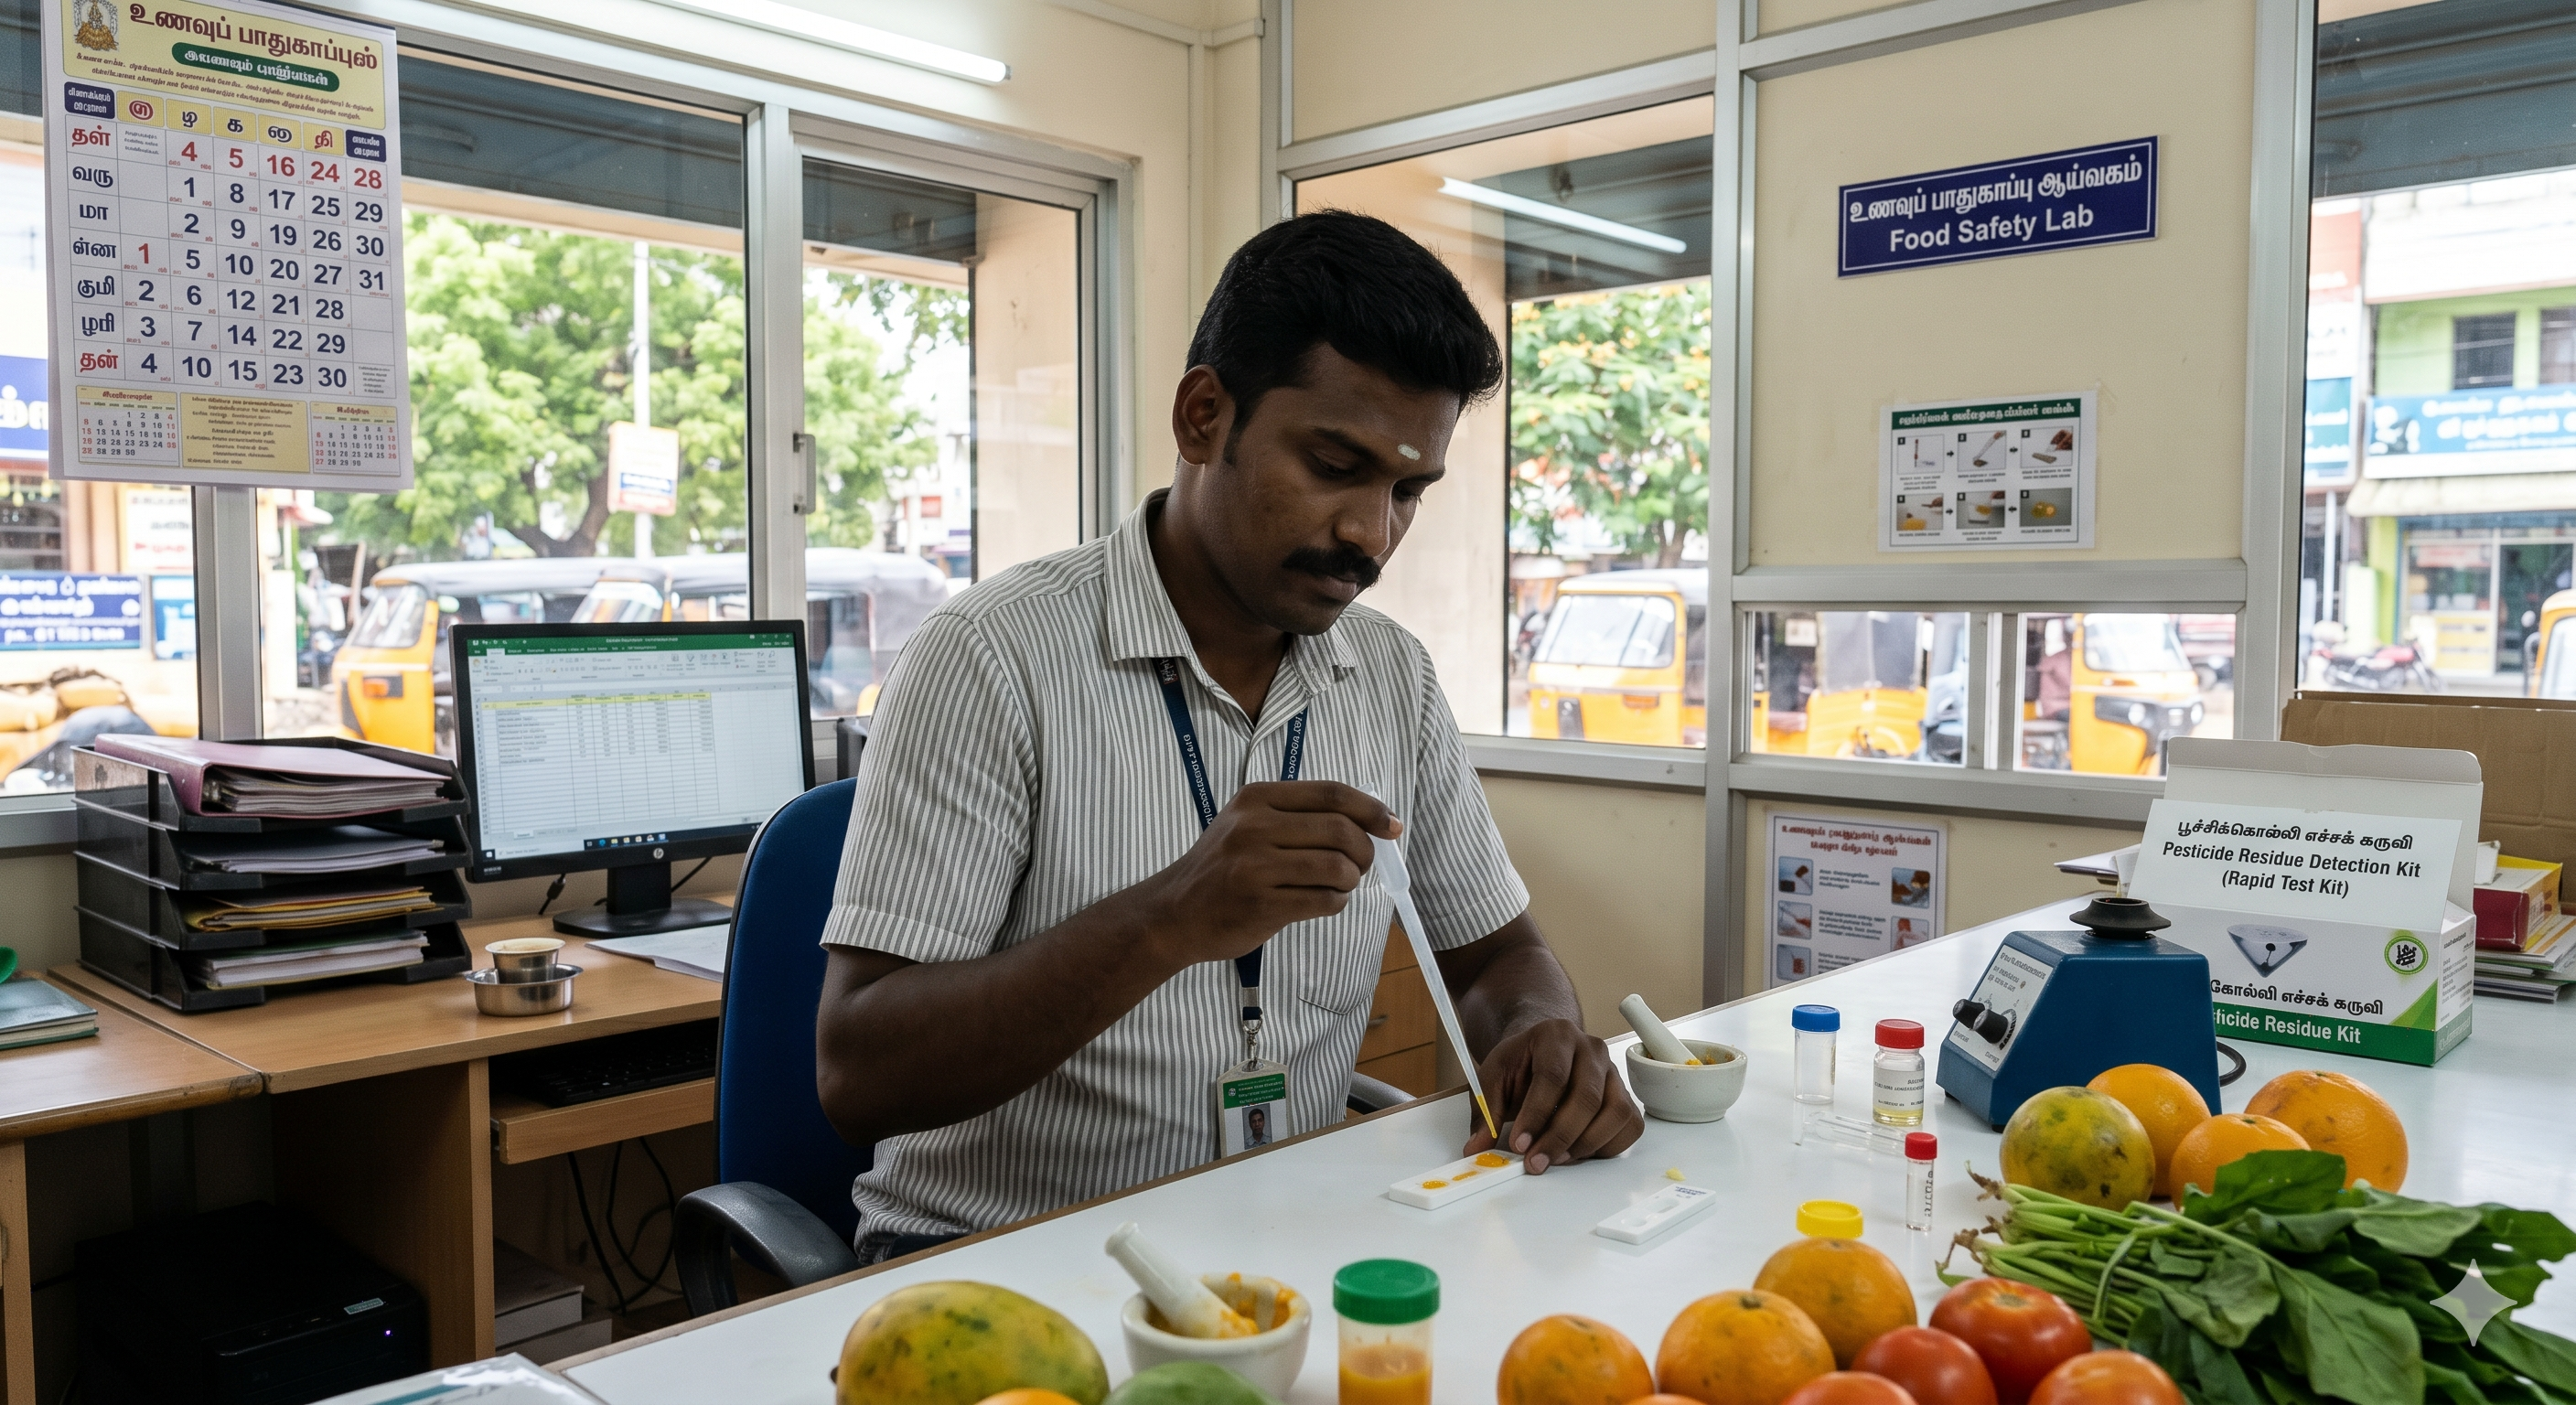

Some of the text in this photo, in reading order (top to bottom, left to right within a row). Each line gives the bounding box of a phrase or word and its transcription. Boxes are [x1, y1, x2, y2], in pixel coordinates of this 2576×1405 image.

[130, 3, 231, 42] உணவுப்
[227, 118, 243, 133] க
[182, 142, 198, 161] 4
[230, 148, 243, 168] 5
[267, 155, 295, 177] 16
[311, 161, 339, 182] 24
[354, 168, 381, 188] 28
[185, 177, 194, 197] 1
[231, 184, 243, 203] 8
[269, 189, 295, 209] 17
[312, 196, 339, 217] 25
[356, 202, 382, 222] 29
[1850, 154, 2142, 222] உணவுப் பாதுகாப்பு ஆய்வகம்
[80, 204, 383, 256] மா 2 9 19 26 30
[1890, 203, 2094, 252] Food Safety Lab
[139, 243, 148, 263] 1
[186, 250, 200, 269] 5
[226, 254, 253, 274] 10
[271, 259, 299, 280] 20
[315, 264, 341, 284] 27
[360, 270, 382, 290] 31
[139, 280, 154, 301] 2
[188, 285, 201, 305] 6
[227, 289, 255, 311] 12
[273, 294, 298, 315] 21
[316, 299, 343, 319] 28
[141, 316, 156, 337] 3
[188, 321, 202, 340] 7
[228, 325, 256, 346] 14
[273, 329, 302, 350] 22
[317, 334, 345, 353] 29
[142, 353, 157, 373] 4
[183, 357, 211, 378] 10
[229, 360, 257, 381] 15
[274, 364, 303, 384] 23
[318, 368, 346, 387] 30
[2178, 819, 2413, 851] பூச்சிக்கொல்லி எச்சக் கருவி
[2163, 842, 2420, 878] Pesticide Residue Detection Kit
[2222, 870, 2349, 899] (Rapid Test Kit)
[2281, 990, 2329, 1007] எச்சக்
[2334, 999, 2383, 1015] கருவி
[2265, 1014, 2332, 1039] Residue
[2337, 1025, 2361, 1044] Kit
